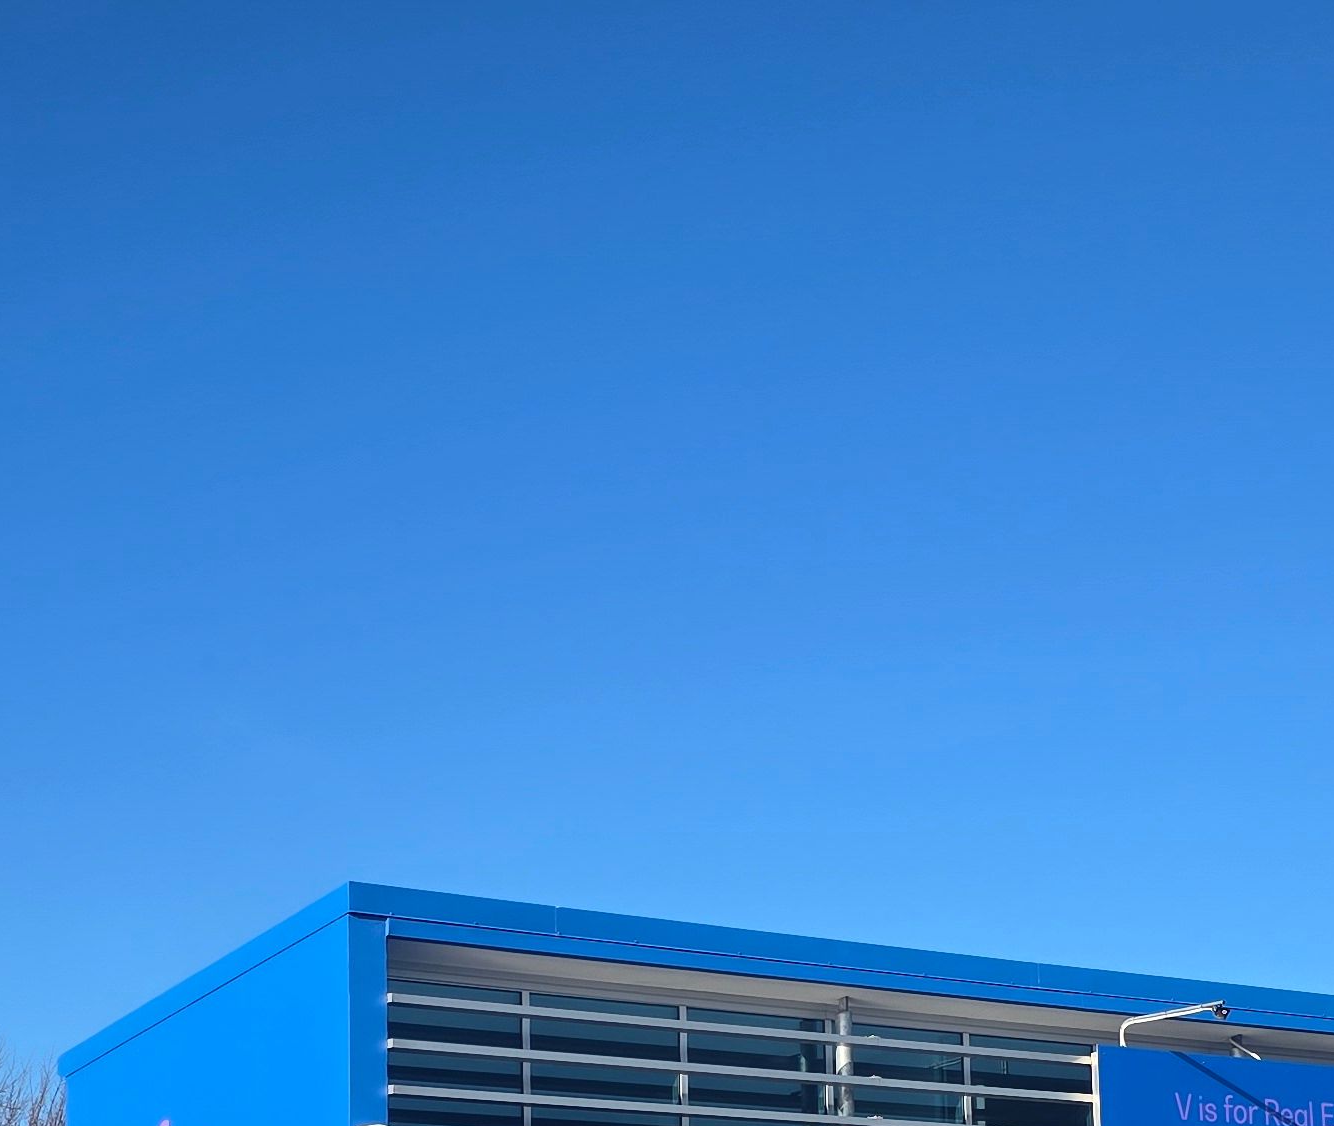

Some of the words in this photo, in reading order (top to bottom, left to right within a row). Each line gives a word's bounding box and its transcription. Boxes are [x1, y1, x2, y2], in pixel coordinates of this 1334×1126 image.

[1174, 1092, 1193, 1121] V
[1198, 1096, 1218, 1124] is
[1223, 1095, 1258, 1126] for
